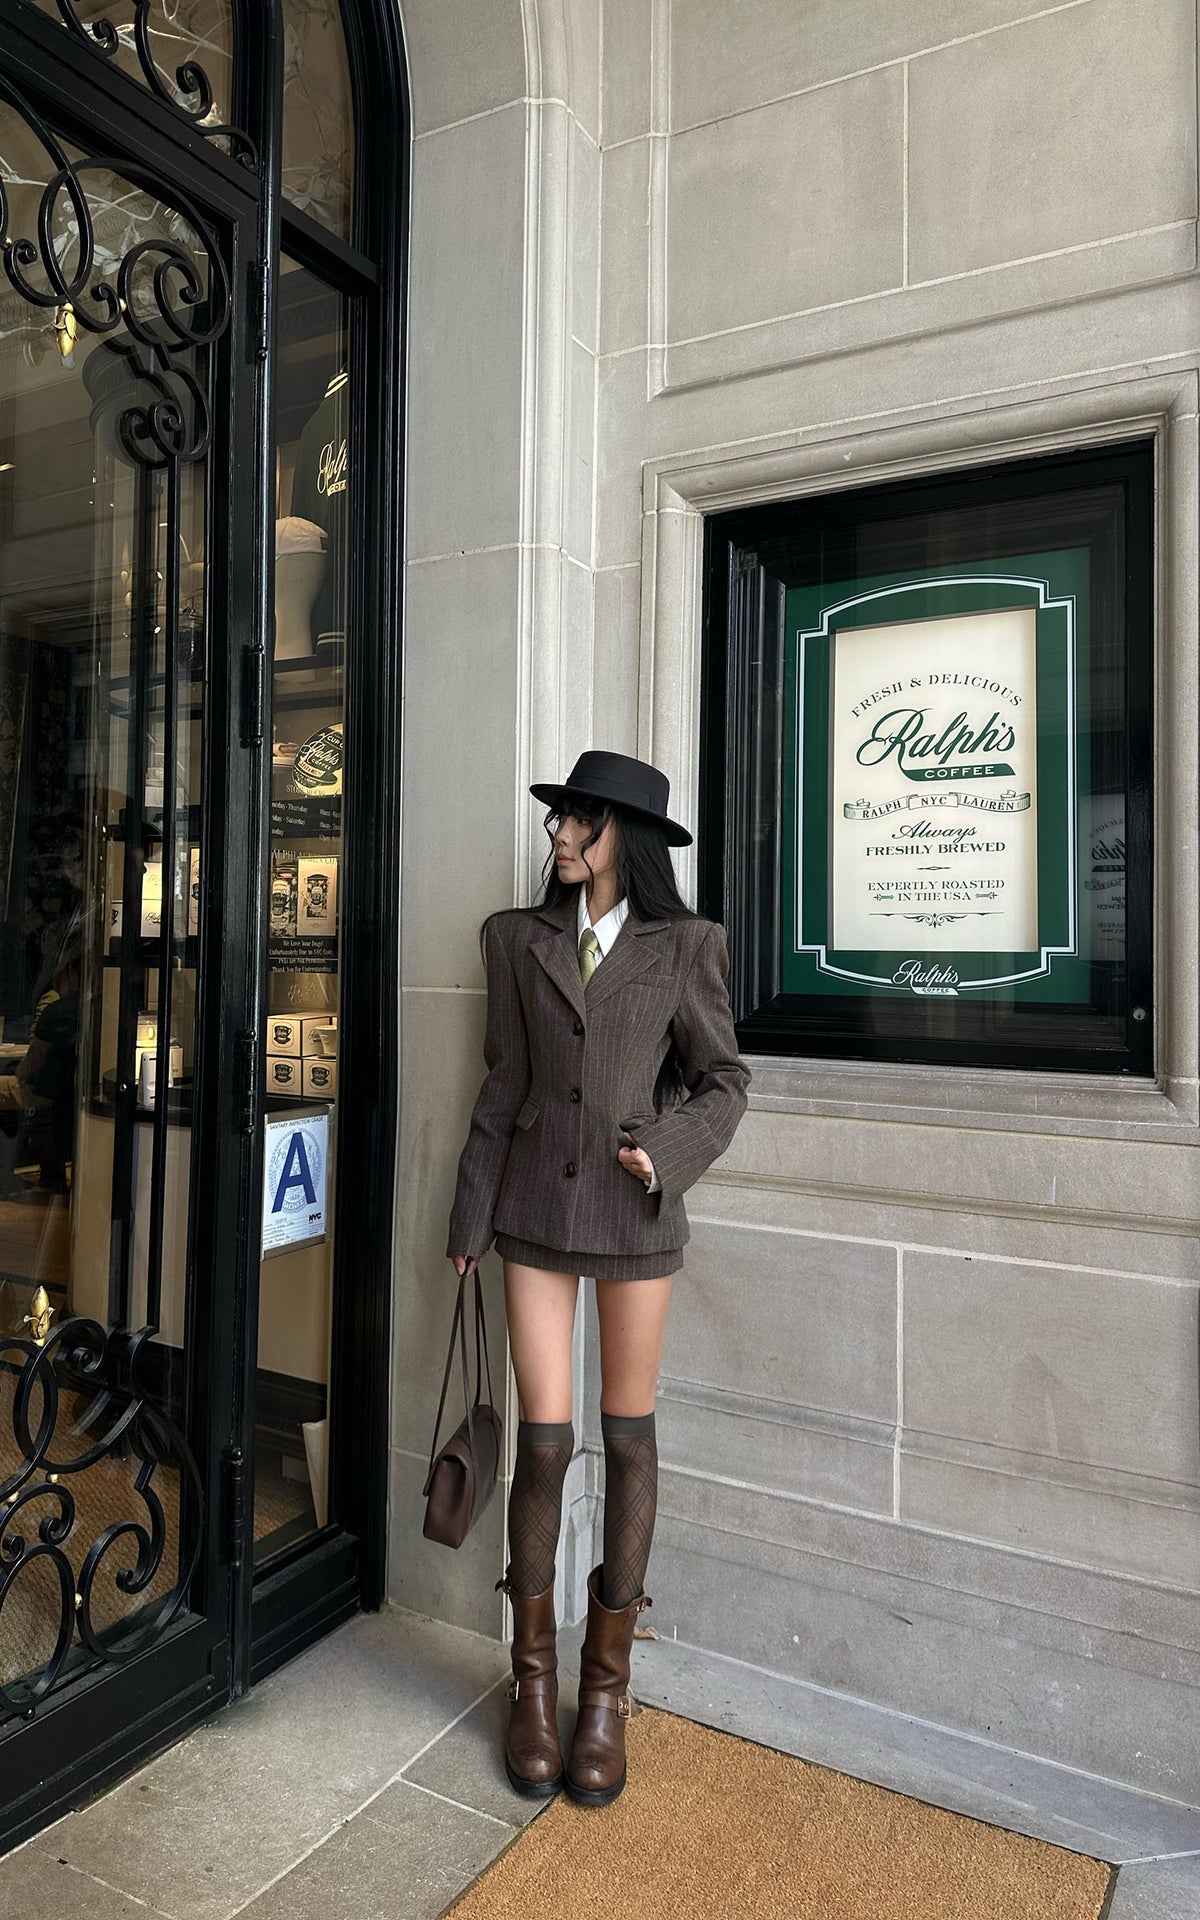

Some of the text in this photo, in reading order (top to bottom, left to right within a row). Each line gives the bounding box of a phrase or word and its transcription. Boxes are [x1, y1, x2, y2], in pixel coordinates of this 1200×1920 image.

[851, 673, 1022, 718] FRESH & DELICIOUS
[856, 708, 1015, 766] Ralph's
[924, 765, 995, 779] COFFEE
[862, 795, 1014, 819] RALPH NYC LAUREN
[891, 820, 978, 844] Always
[866, 841, 1006, 857] FRESHLY BREWED
[868, 879, 1005, 891] EXPERTLY ROASTED
[898, 892, 971, 901] IN THE USA
[893, 959, 959, 987] Ralph's
[270, 1122, 288, 1130] SANITARY
[289, 1119, 311, 1127] INSPECTION
[271, 1131, 317, 1214] A
[308, 1212, 322, 1222] NYC
